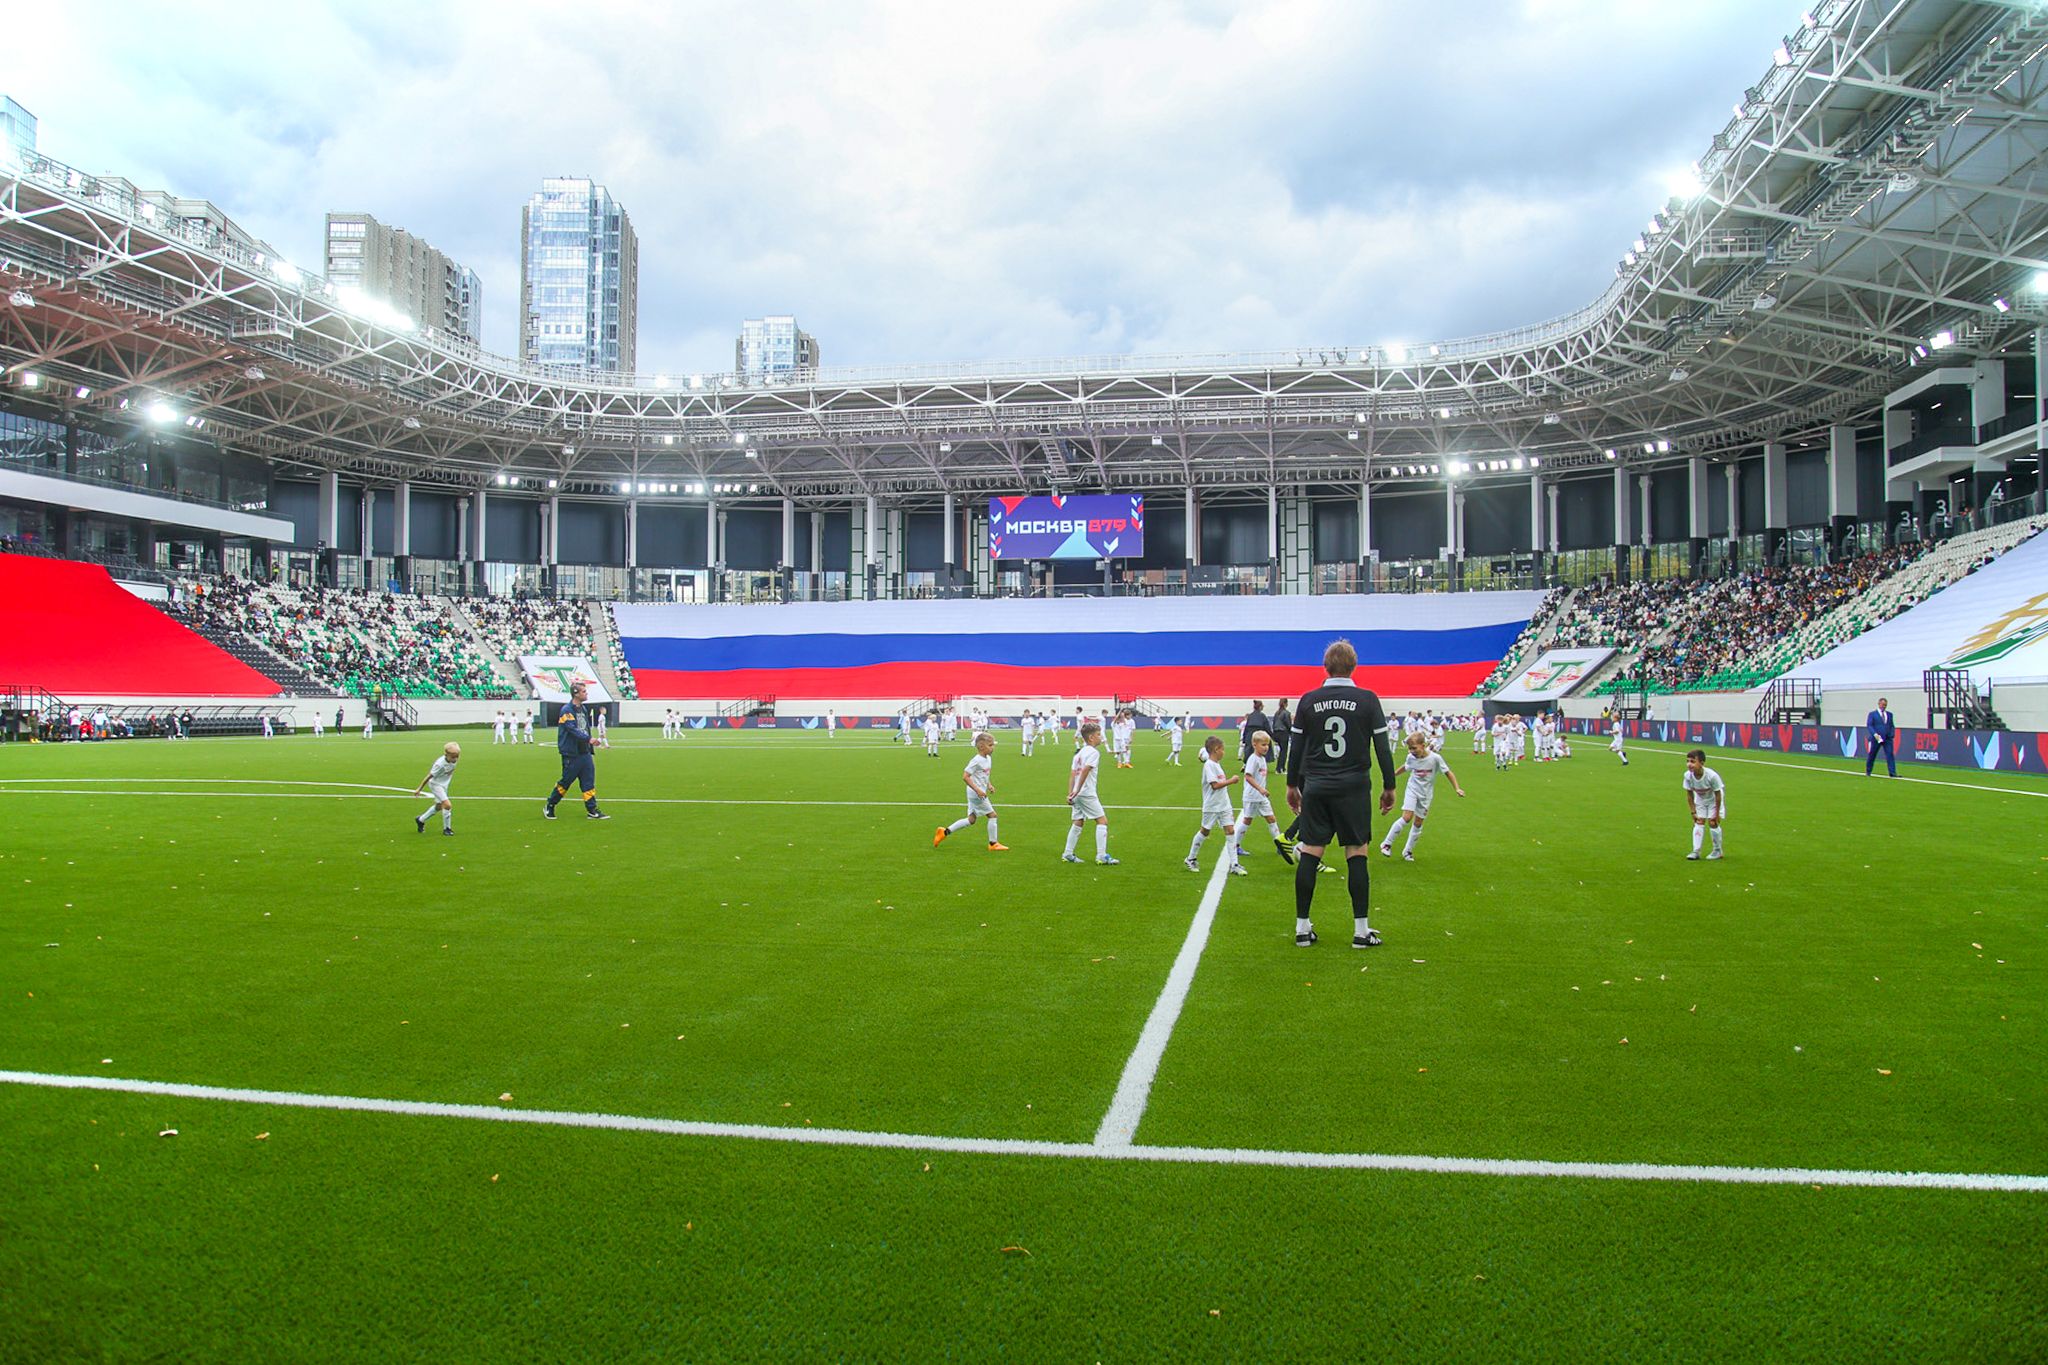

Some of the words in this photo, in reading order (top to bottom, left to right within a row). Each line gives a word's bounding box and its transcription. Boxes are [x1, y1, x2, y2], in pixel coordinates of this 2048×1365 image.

[1991, 481, 2004, 500] 4
[1936, 500, 1946, 516] 3
[1900, 511, 1911, 527] 3
[1846, 524, 1855, 540] 2
[1313, 700, 1357, 713] ЩИГОЛЕВ
[1324, 715, 1347, 759] 3
